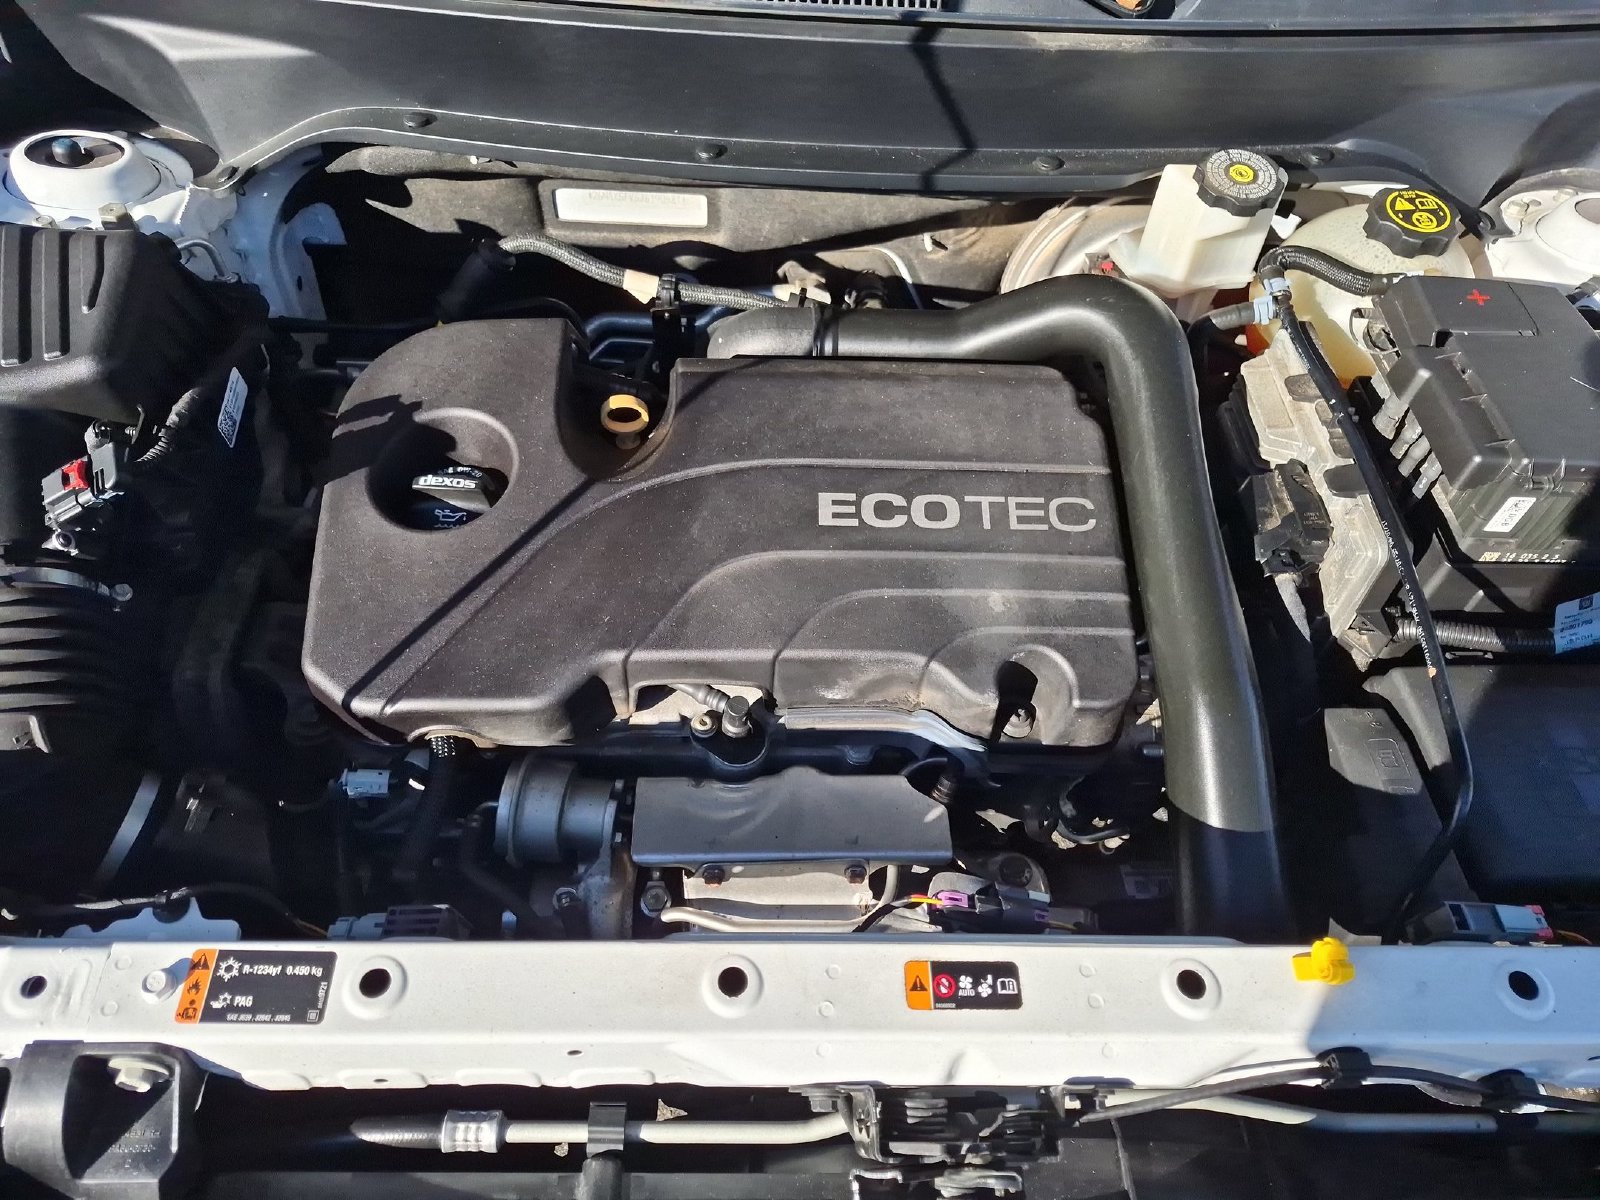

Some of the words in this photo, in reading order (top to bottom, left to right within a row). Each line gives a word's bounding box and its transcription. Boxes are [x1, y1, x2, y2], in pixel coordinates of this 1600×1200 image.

[418, 474, 476, 489] dexos
[817, 492, 1097, 533] ECOTEC
[242, 964, 282, 977] R-1234yf
[286, 965, 311, 976] 0.450
[311, 965, 324, 978] kg
[958, 988, 975, 997] AUTO
[234, 995, 253, 1007] PAG
